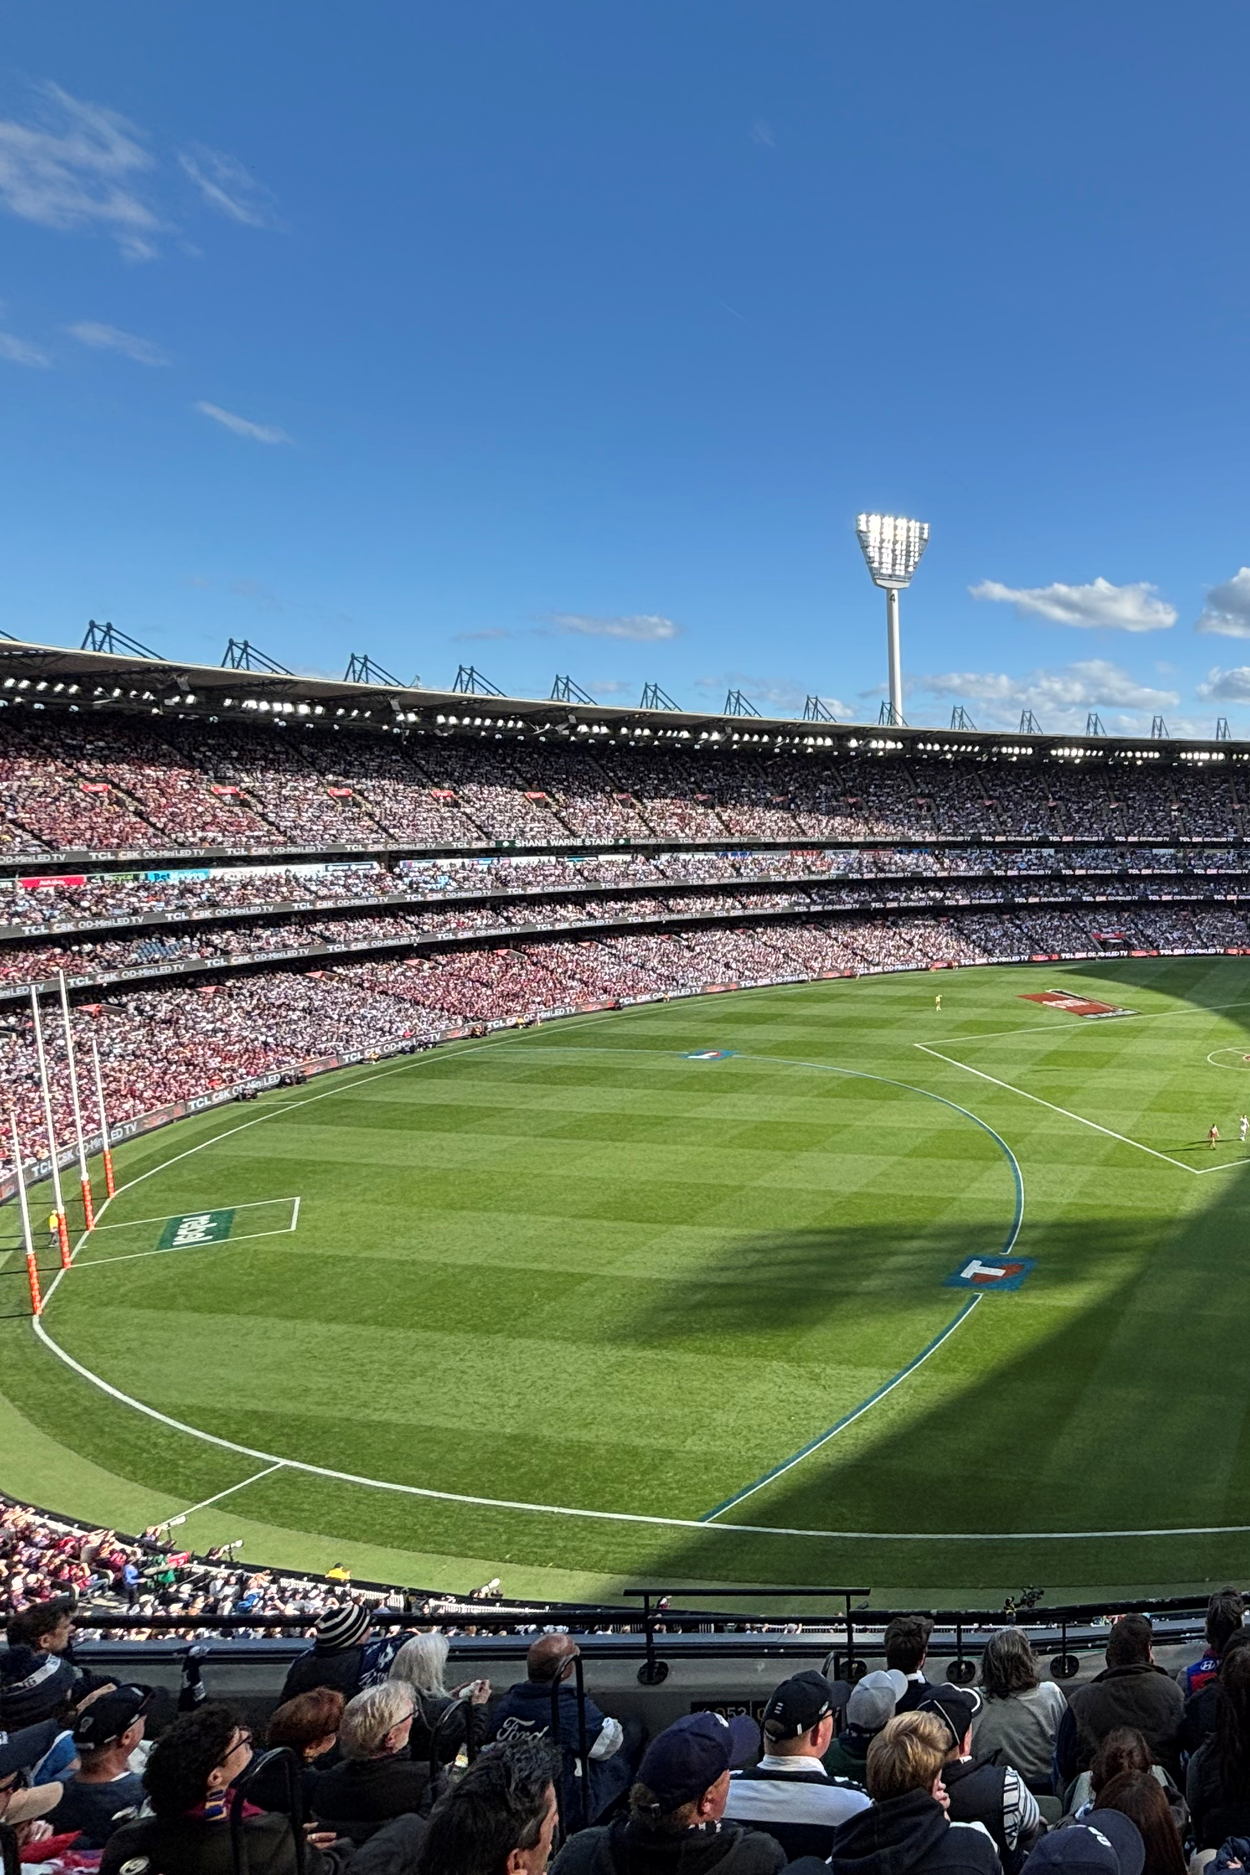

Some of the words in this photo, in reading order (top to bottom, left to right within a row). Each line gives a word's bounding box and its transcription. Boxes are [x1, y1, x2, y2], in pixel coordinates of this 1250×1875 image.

[514, 838, 548, 847] SHANE
[550, 838, 583, 846] WARNE
[585, 837, 615, 845] STAND
[165, 912, 189, 921] TCL
[22, 926, 49, 935] TCL
[436, 932, 455, 940] TCL
[327, 943, 348, 952] TCL
[205, 958, 228, 967] TCL
[67, 976, 93, 986] TCL
[740, 980, 756, 988] TCL
[343, 1052, 364, 1062] TCL
[188, 1096, 212, 1110] TCL
[32, 1162, 52, 1177] TCL
[496, 1716, 550, 1741] Ford
